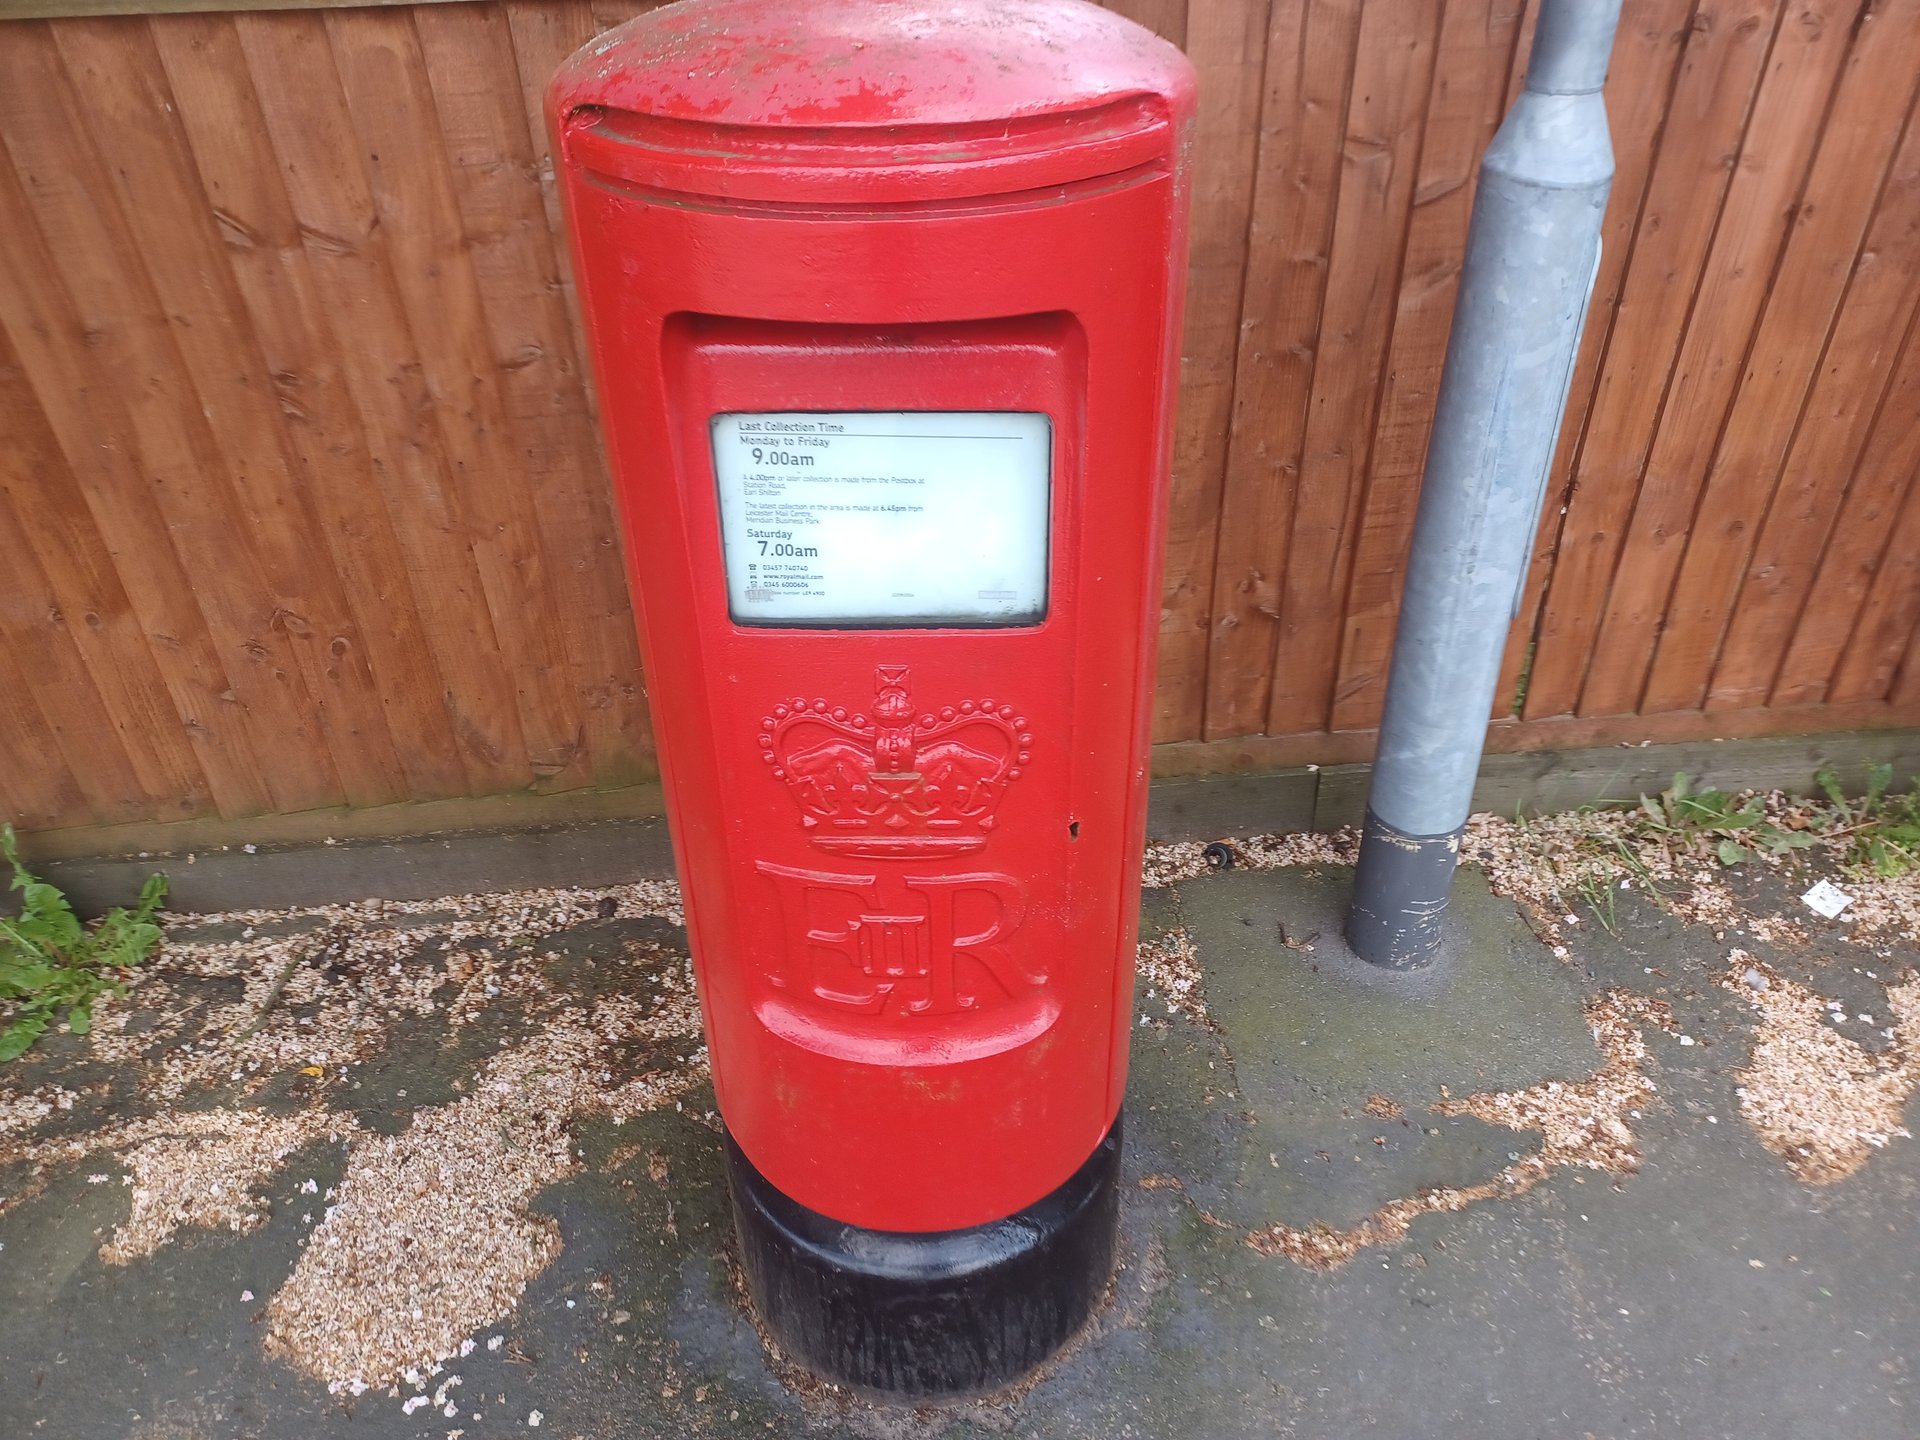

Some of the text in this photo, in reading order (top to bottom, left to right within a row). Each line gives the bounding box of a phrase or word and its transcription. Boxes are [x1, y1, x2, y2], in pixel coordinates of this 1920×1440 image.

[738, 421, 845, 433] Last Collection Time
[739, 435, 831, 448] Monday to Friday
[752, 447, 815, 466] 9.00am
[758, 488, 782, 496] Shilton
[744, 501, 758, 509] The
[880, 504, 907, 513] 6.45pm
[745, 516, 820, 525] Meridian Business Park
[746, 528, 793, 541] Saturday
[757, 540, 818, 558] 7.00am
[783, 564, 808, 572] 740740
[763, 573, 824, 581] www.royalmail.com
